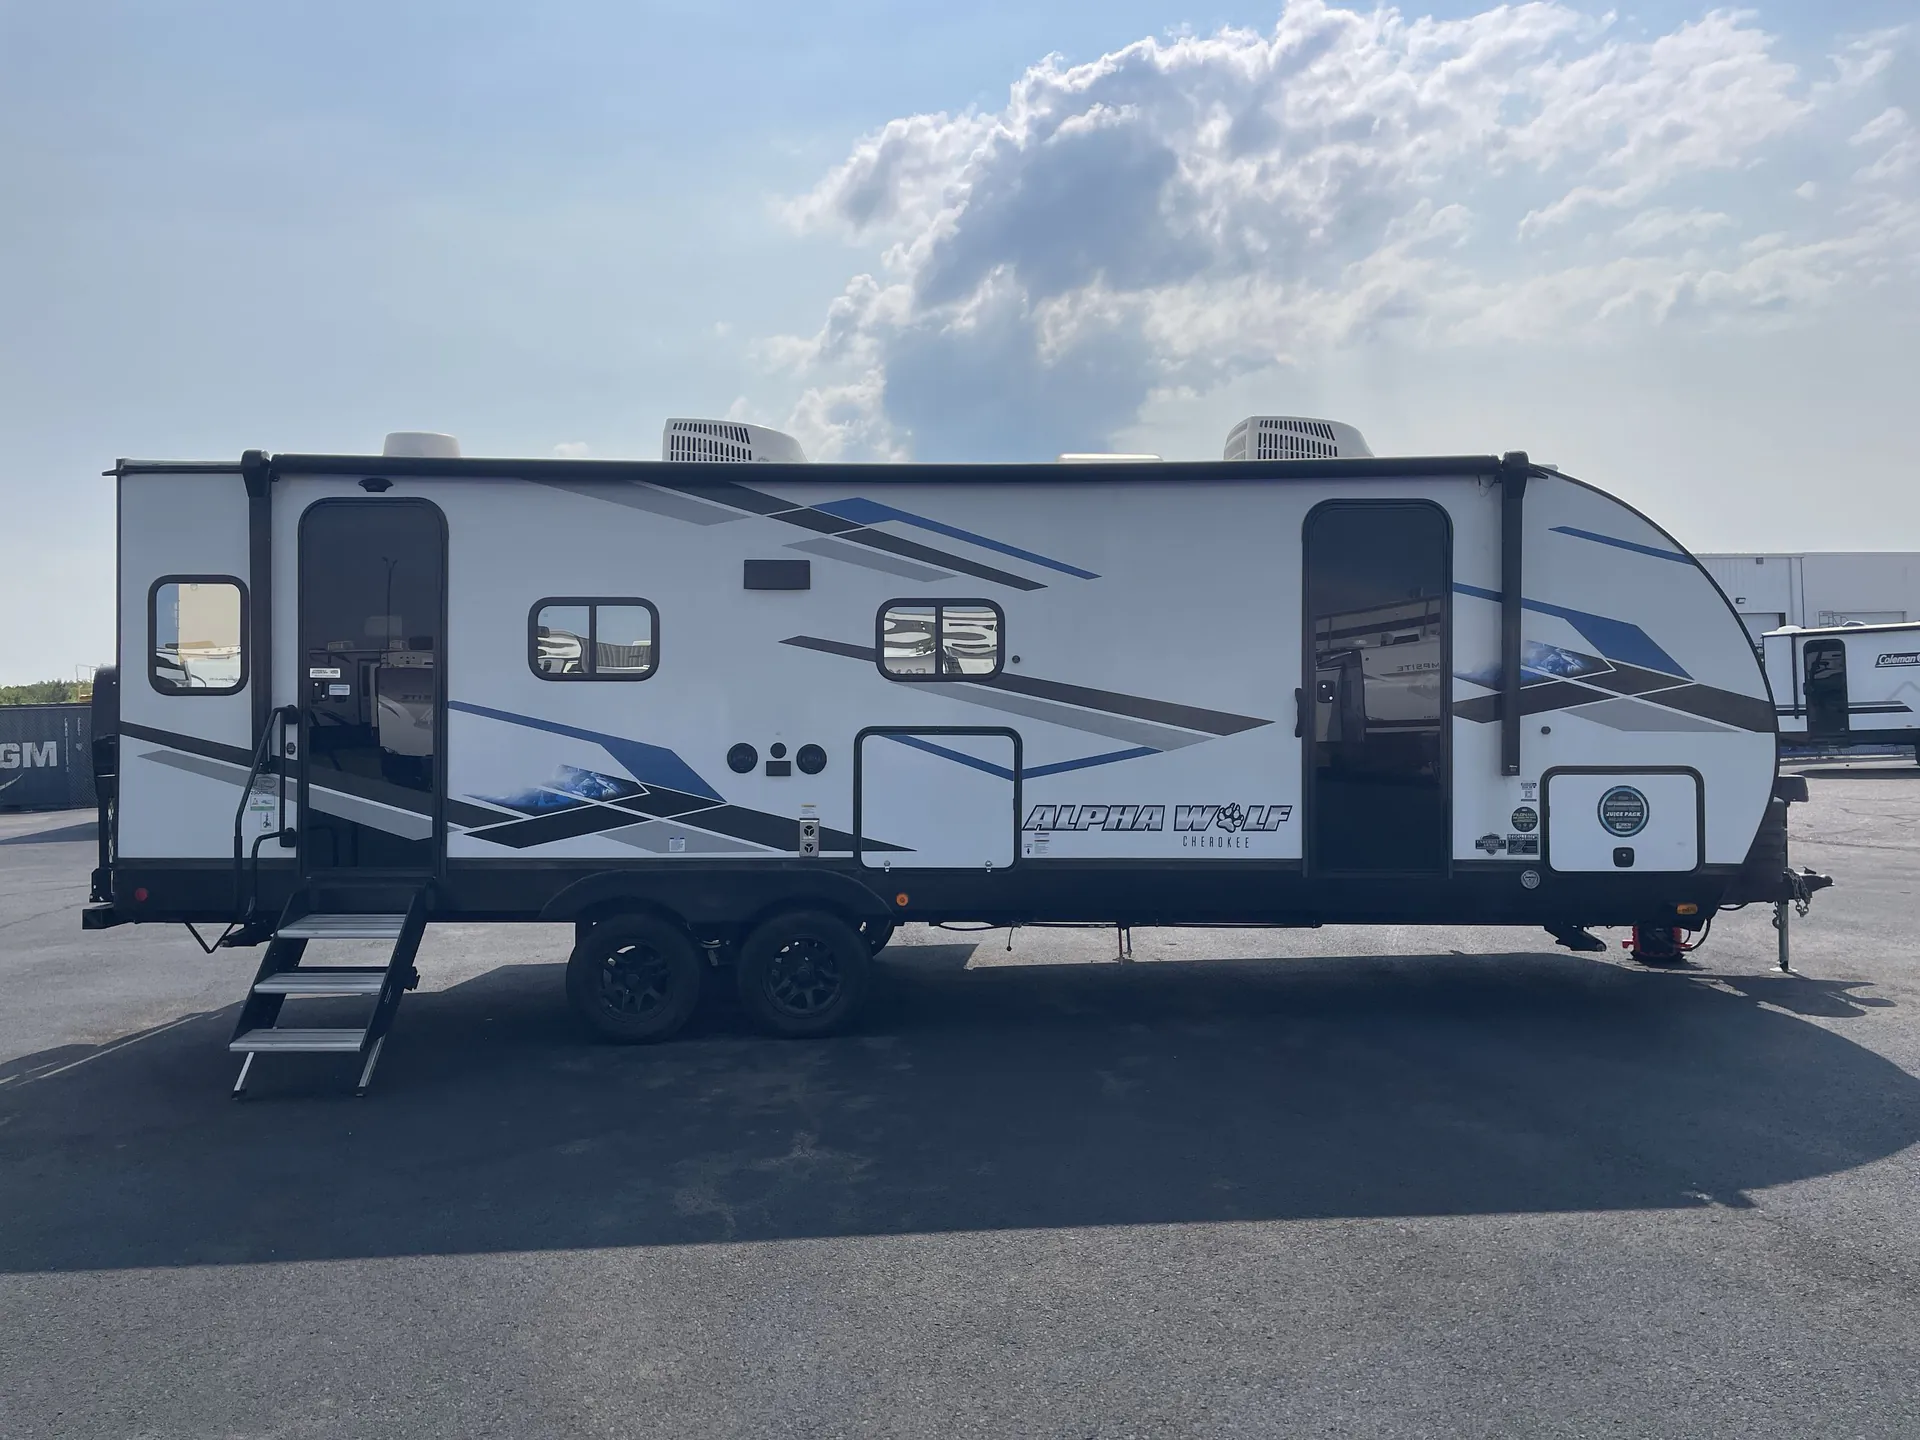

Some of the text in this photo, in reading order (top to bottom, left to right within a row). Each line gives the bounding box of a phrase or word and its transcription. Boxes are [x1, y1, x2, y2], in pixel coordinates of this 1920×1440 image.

[1879, 655, 1916, 665] Coleman
[1022, 805, 1165, 831] ALPHA
[1182, 835, 1250, 848] CHEROKEE
